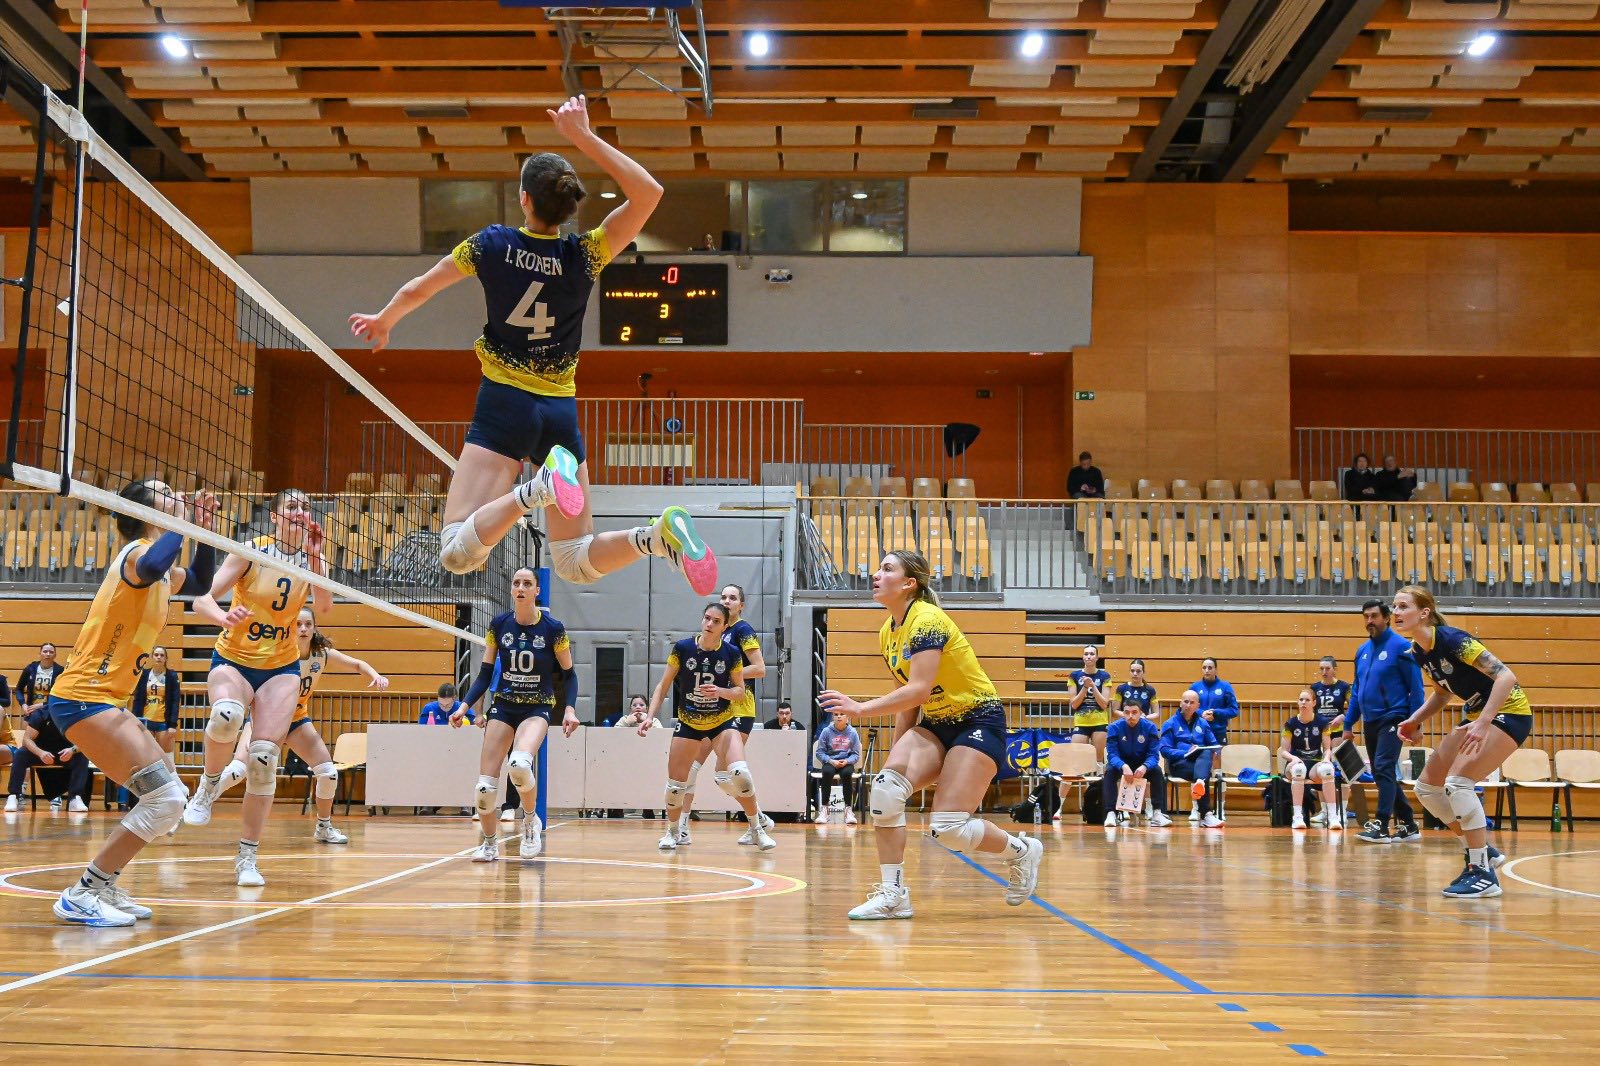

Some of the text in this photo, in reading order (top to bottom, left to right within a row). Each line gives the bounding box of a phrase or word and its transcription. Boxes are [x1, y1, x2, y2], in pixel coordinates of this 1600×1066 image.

[515, 248, 563, 276] KOREN
[505, 280, 556, 341] 4
[659, 303, 669, 319] 3
[620, 326, 631, 341] 2
[271, 577, 292, 612] 3
[509, 649, 534, 672] 10
[35, 677, 51, 692] 33
[150, 683, 158, 696] 9
[1319, 695, 1335, 709] 12
[1303, 737, 1311, 751] 1
